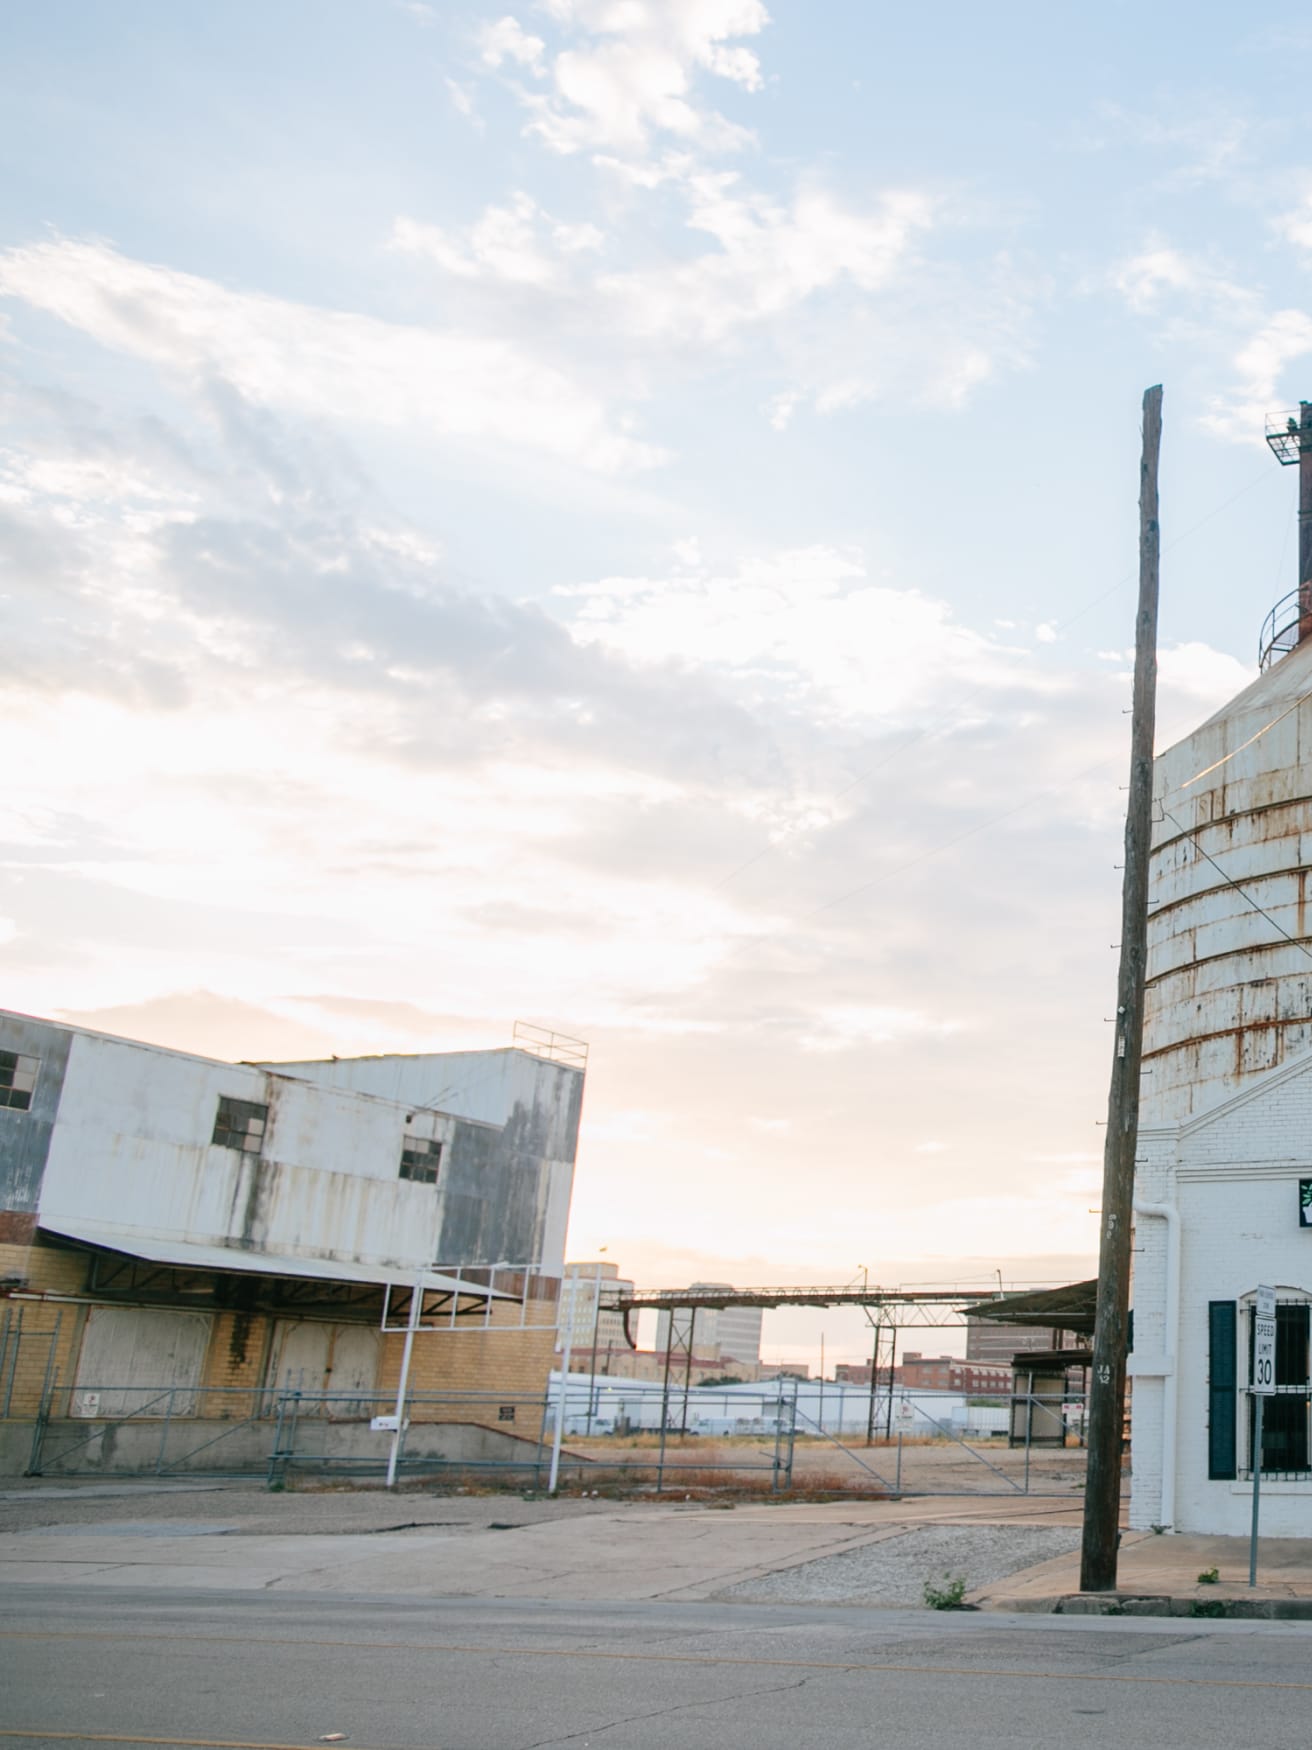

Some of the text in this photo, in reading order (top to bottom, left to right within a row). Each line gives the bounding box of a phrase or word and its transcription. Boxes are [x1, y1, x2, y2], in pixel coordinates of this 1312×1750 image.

[1257, 1323, 1275, 1337] SPEED
[1258, 1343, 1273, 1355] LIMIT
[1257, 1358, 1272, 1385] 30
